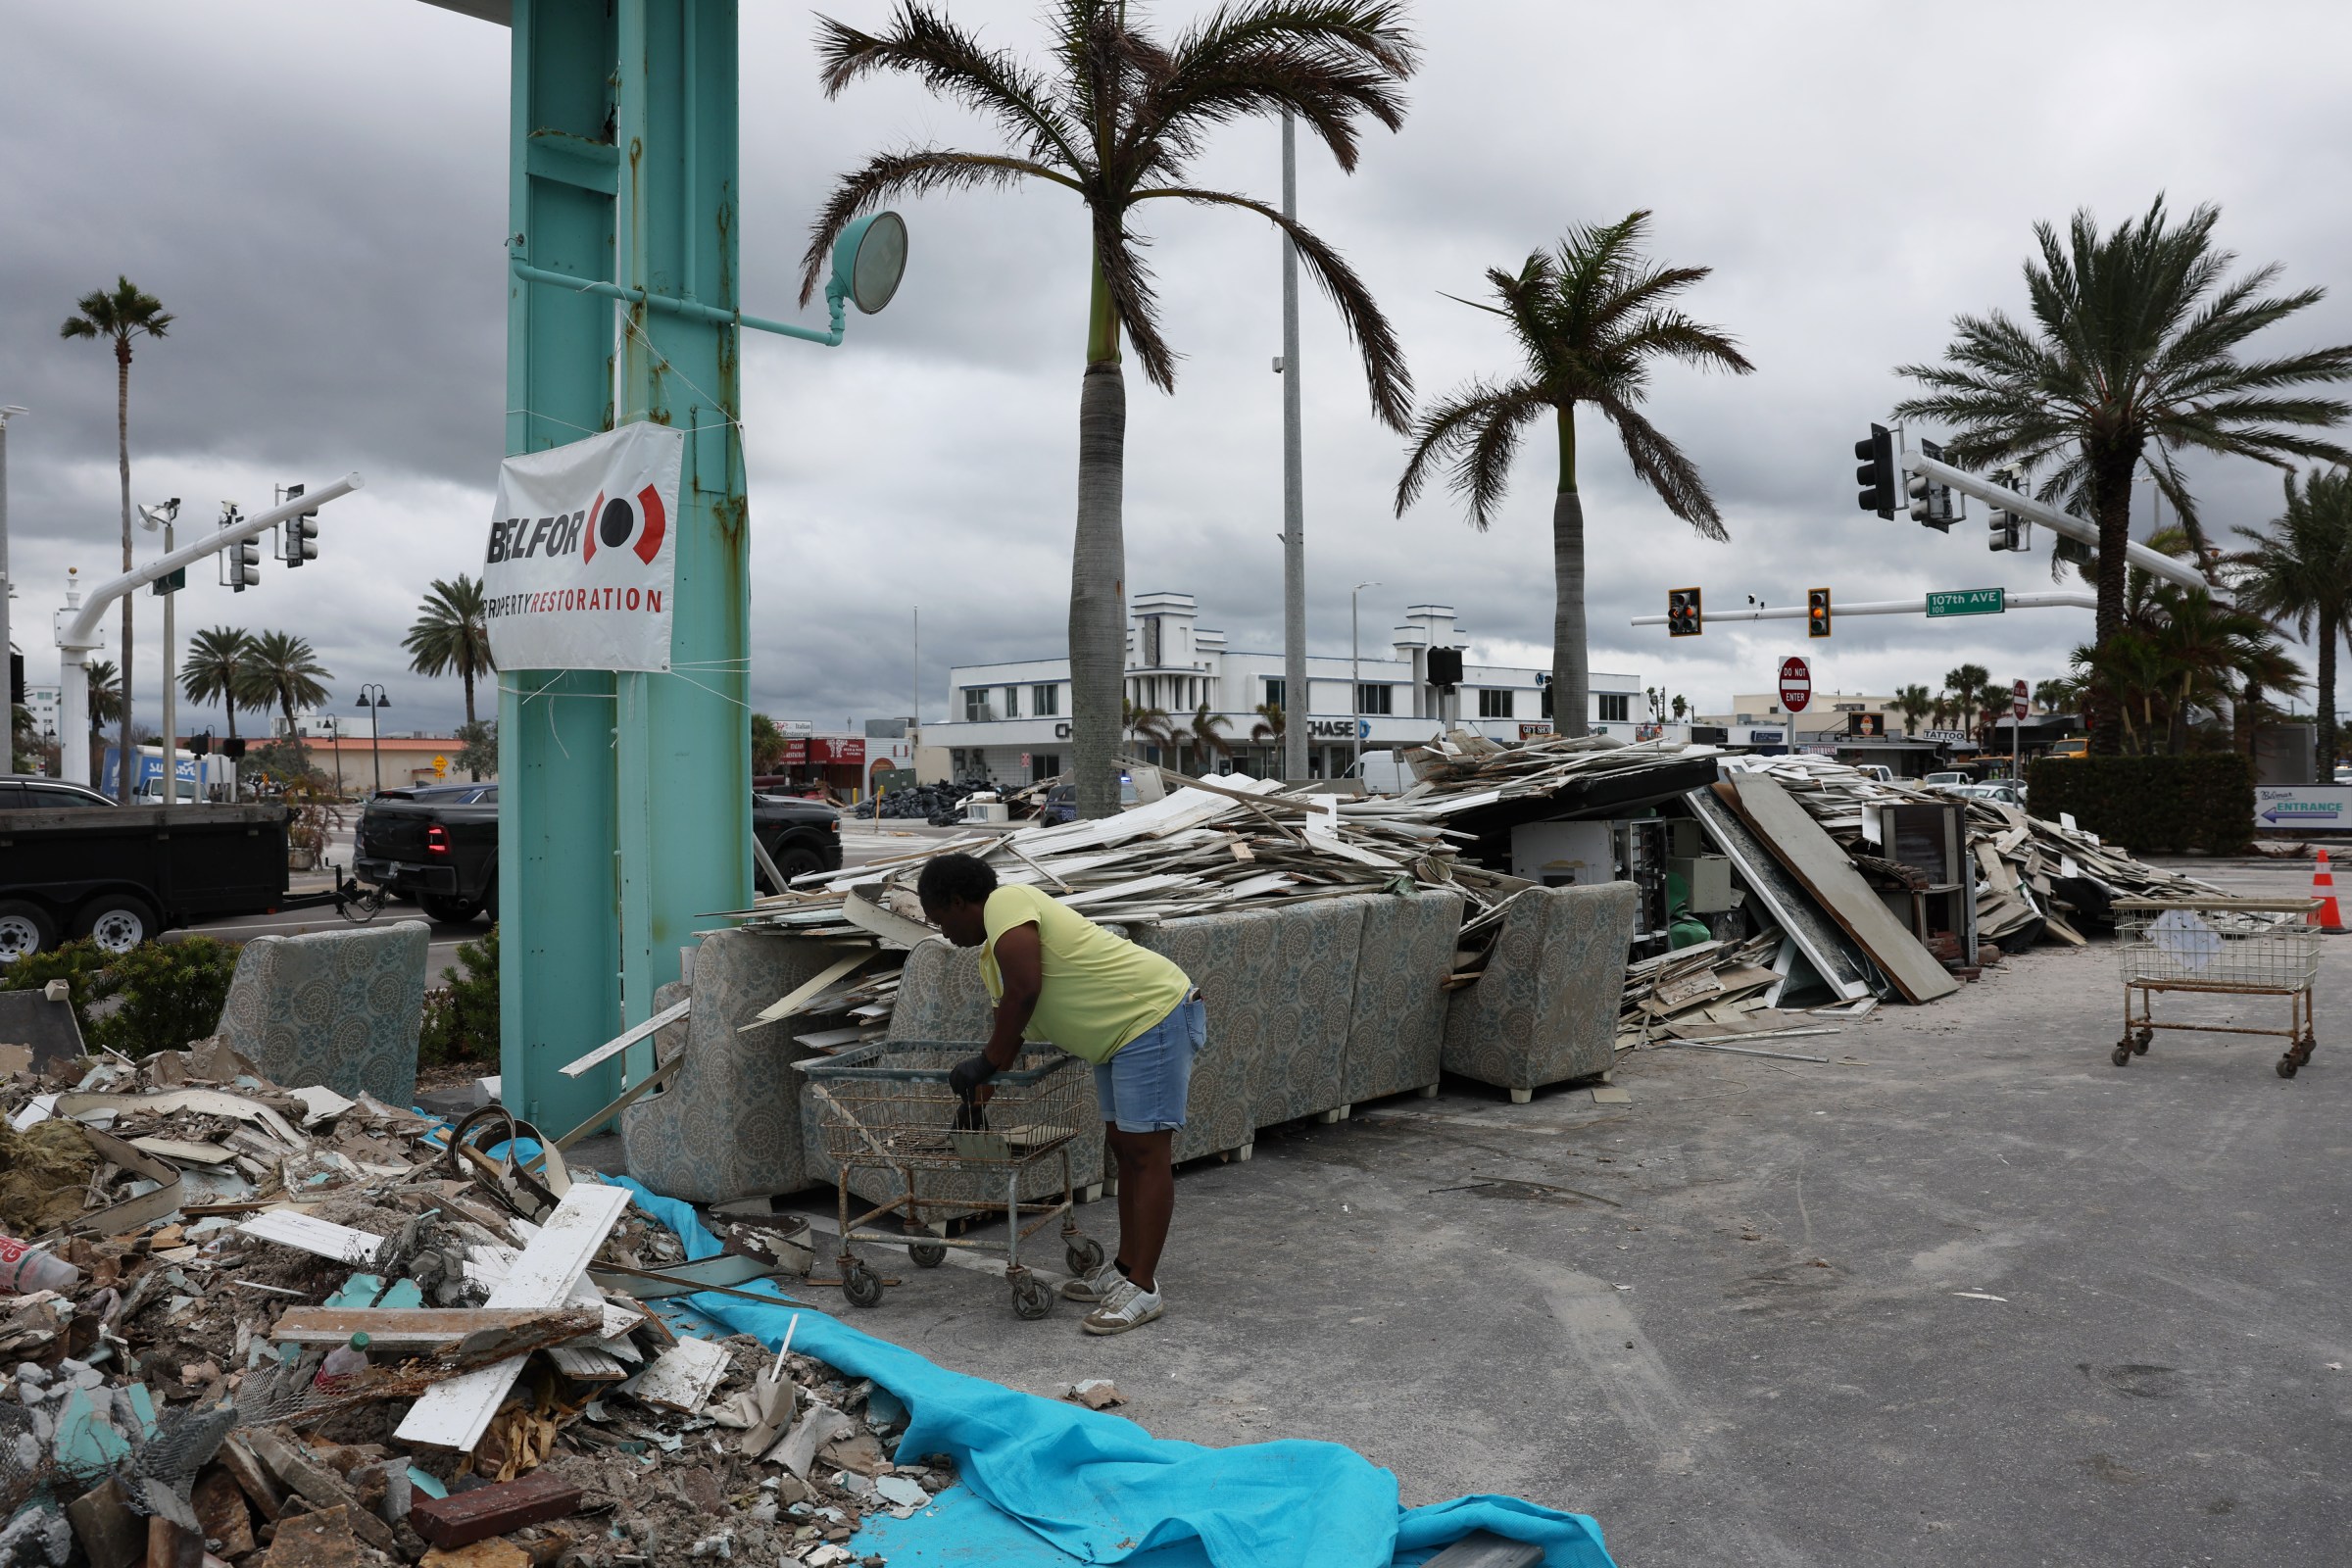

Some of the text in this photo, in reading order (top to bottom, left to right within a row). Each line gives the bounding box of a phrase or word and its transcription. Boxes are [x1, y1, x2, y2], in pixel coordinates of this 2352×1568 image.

[486, 510, 586, 564] BELFOR
[1932, 592, 1997, 606] 107th AVE
[1784, 667, 1806, 677] DO NOT
[1786, 692, 1805, 702] ENTER
[1924, 730, 1964, 740] TATTOO
[2278, 803, 2343, 811] ENTRANCE
